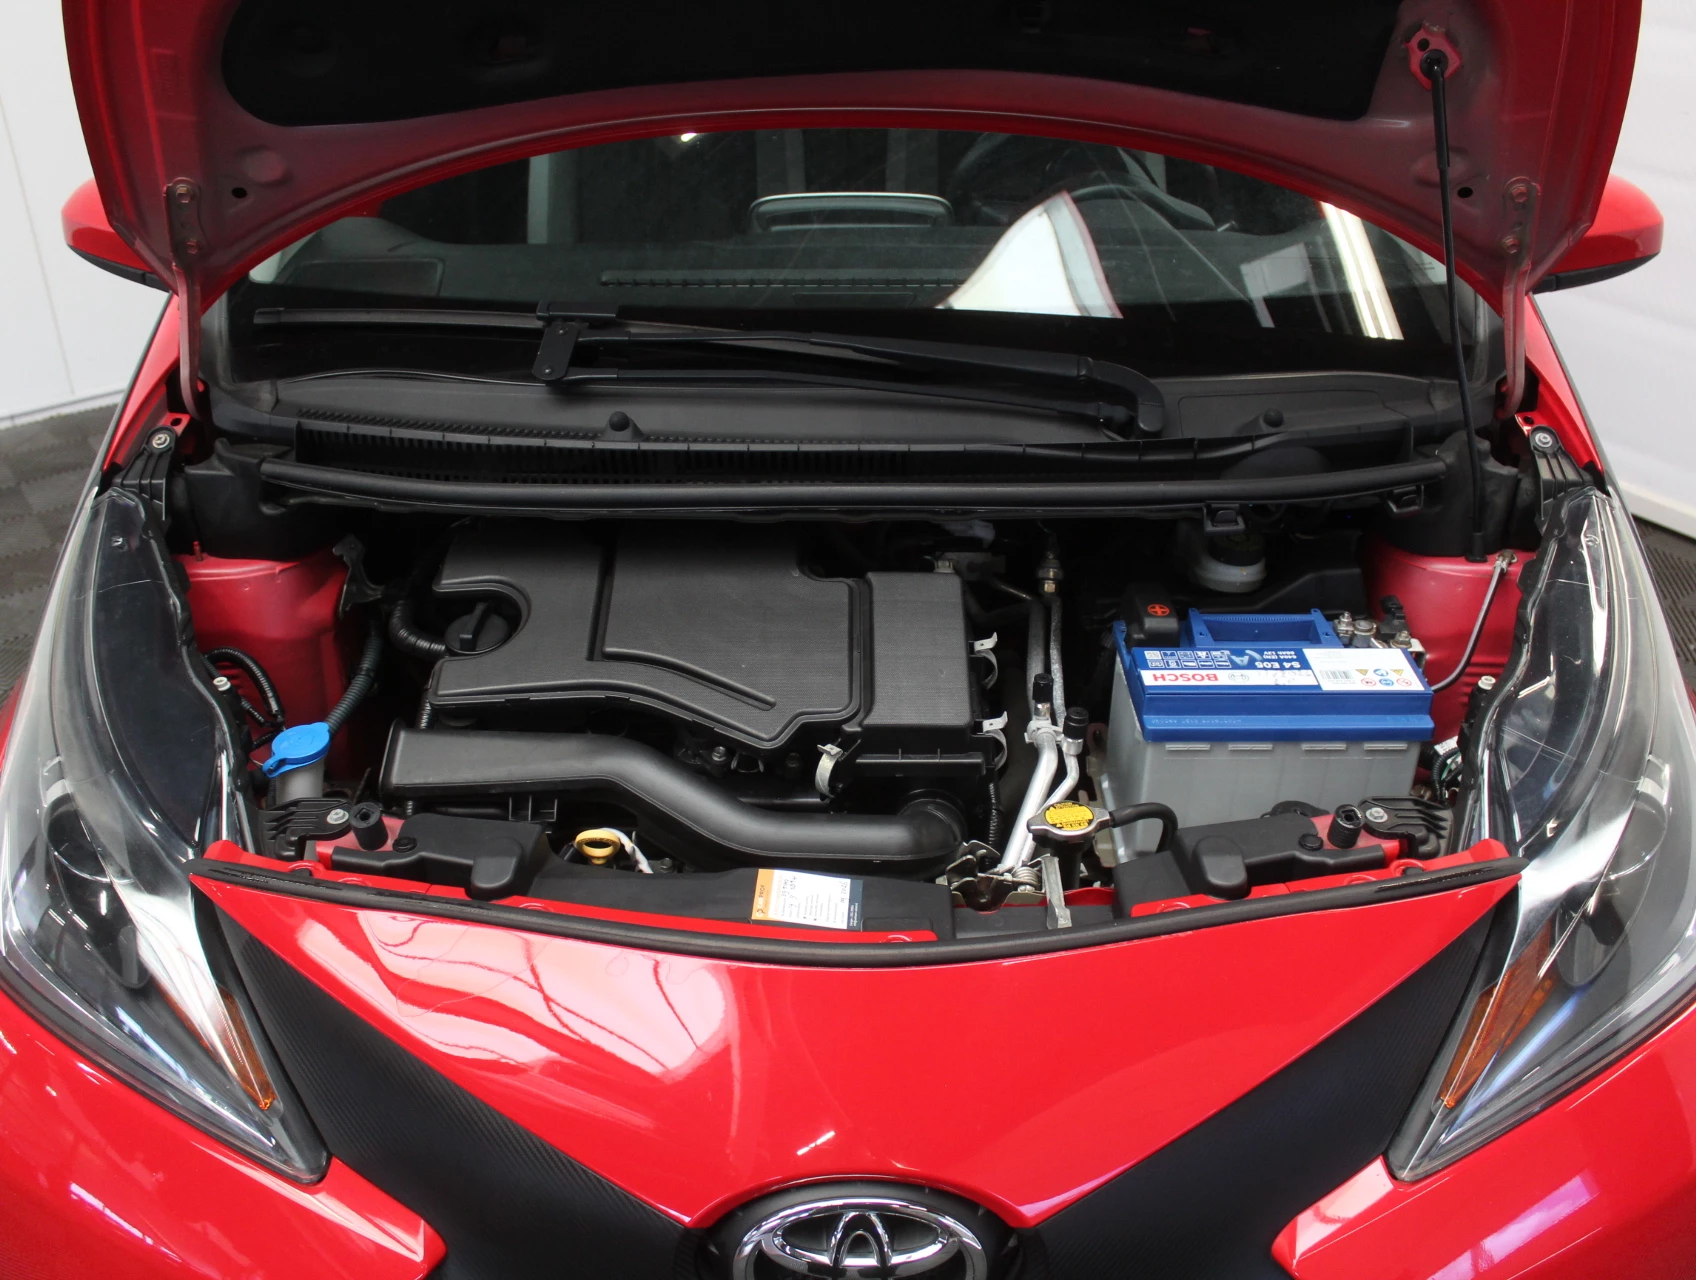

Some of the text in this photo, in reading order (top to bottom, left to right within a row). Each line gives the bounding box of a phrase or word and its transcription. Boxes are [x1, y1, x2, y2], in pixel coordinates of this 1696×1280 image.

[1255, 661, 1301, 669] S4 E05
[1152, 673, 1219, 682] BOSCH
